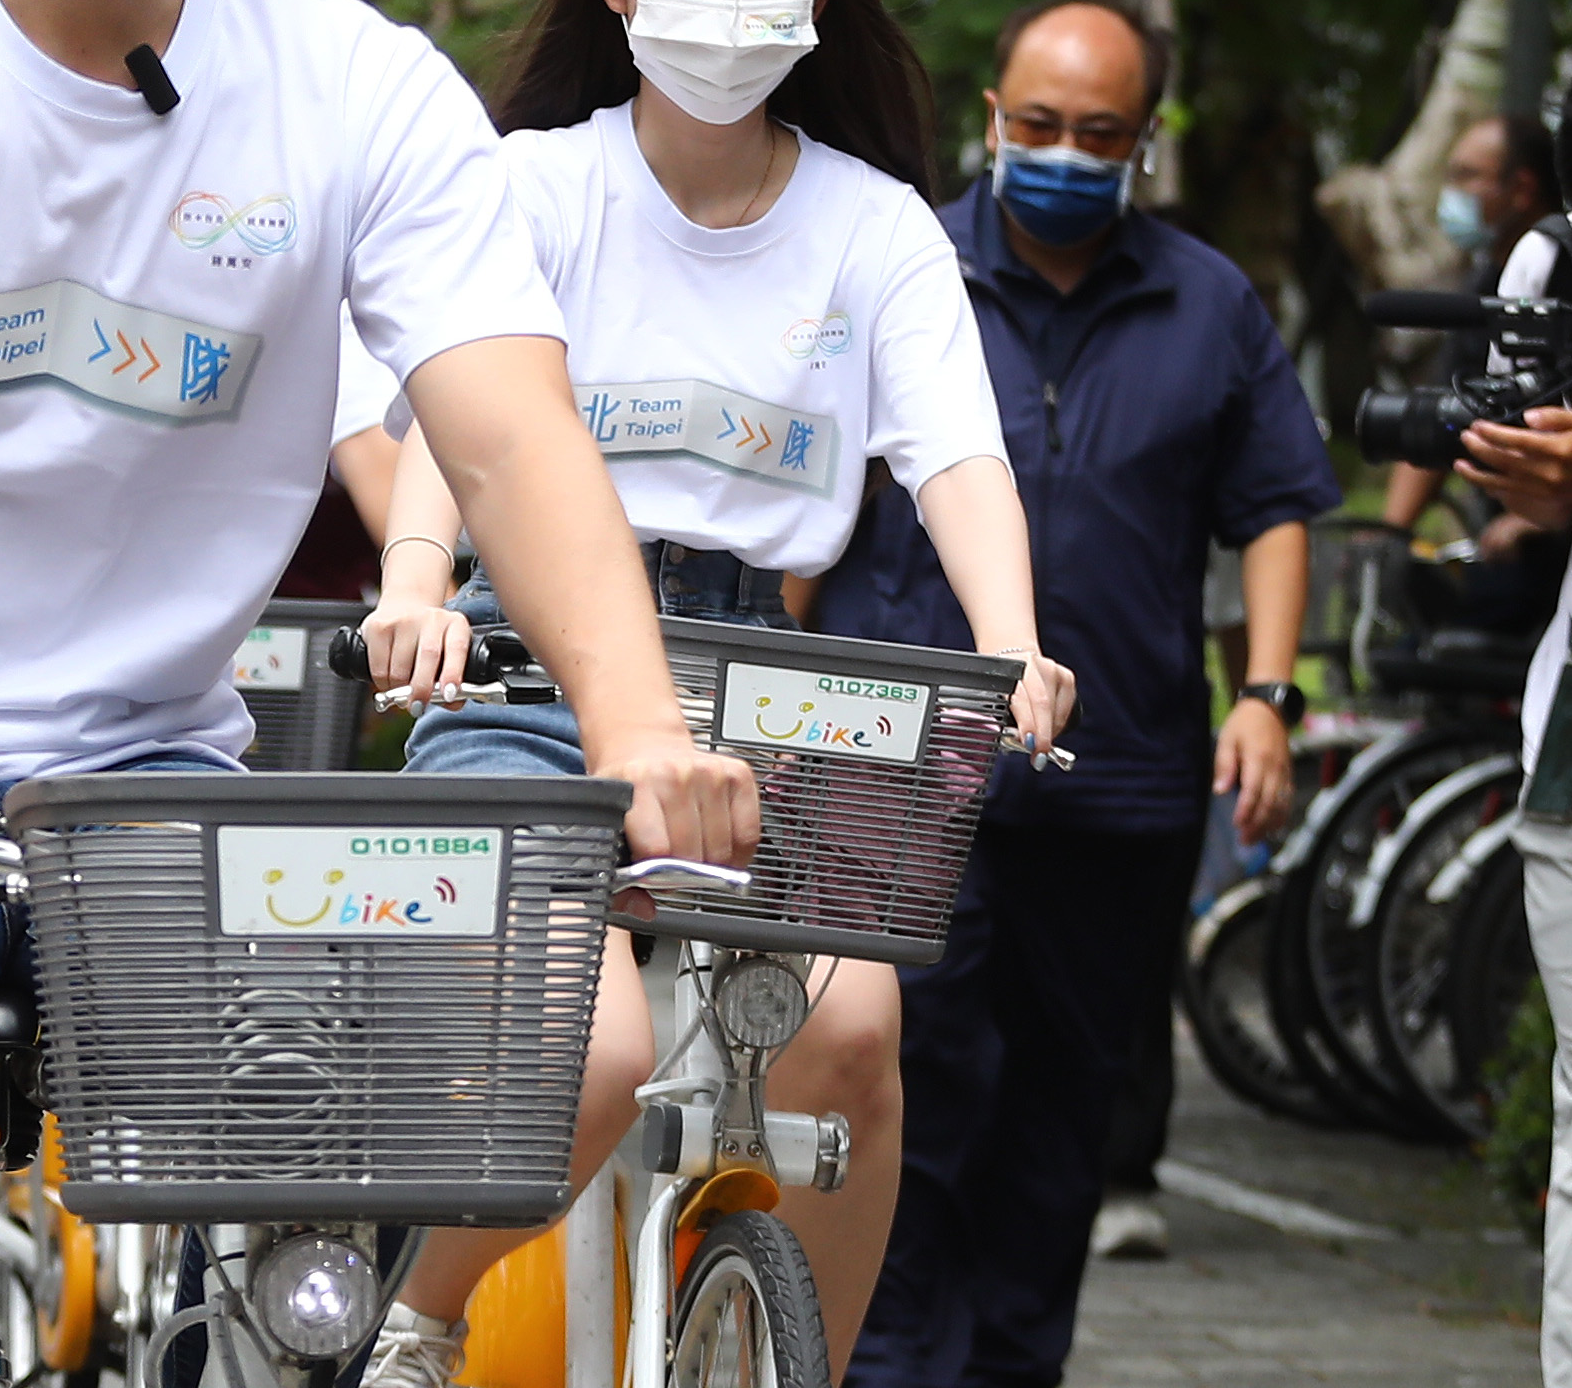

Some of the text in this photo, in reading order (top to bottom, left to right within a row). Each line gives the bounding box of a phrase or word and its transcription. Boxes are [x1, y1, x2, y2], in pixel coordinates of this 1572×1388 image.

[180, 330, 232, 405] 隊
[628, 397, 682, 415] Team
[624, 418, 684, 440] Taipei
[780, 418, 815, 471] 隊
[350, 837, 491, 855] 0101884
